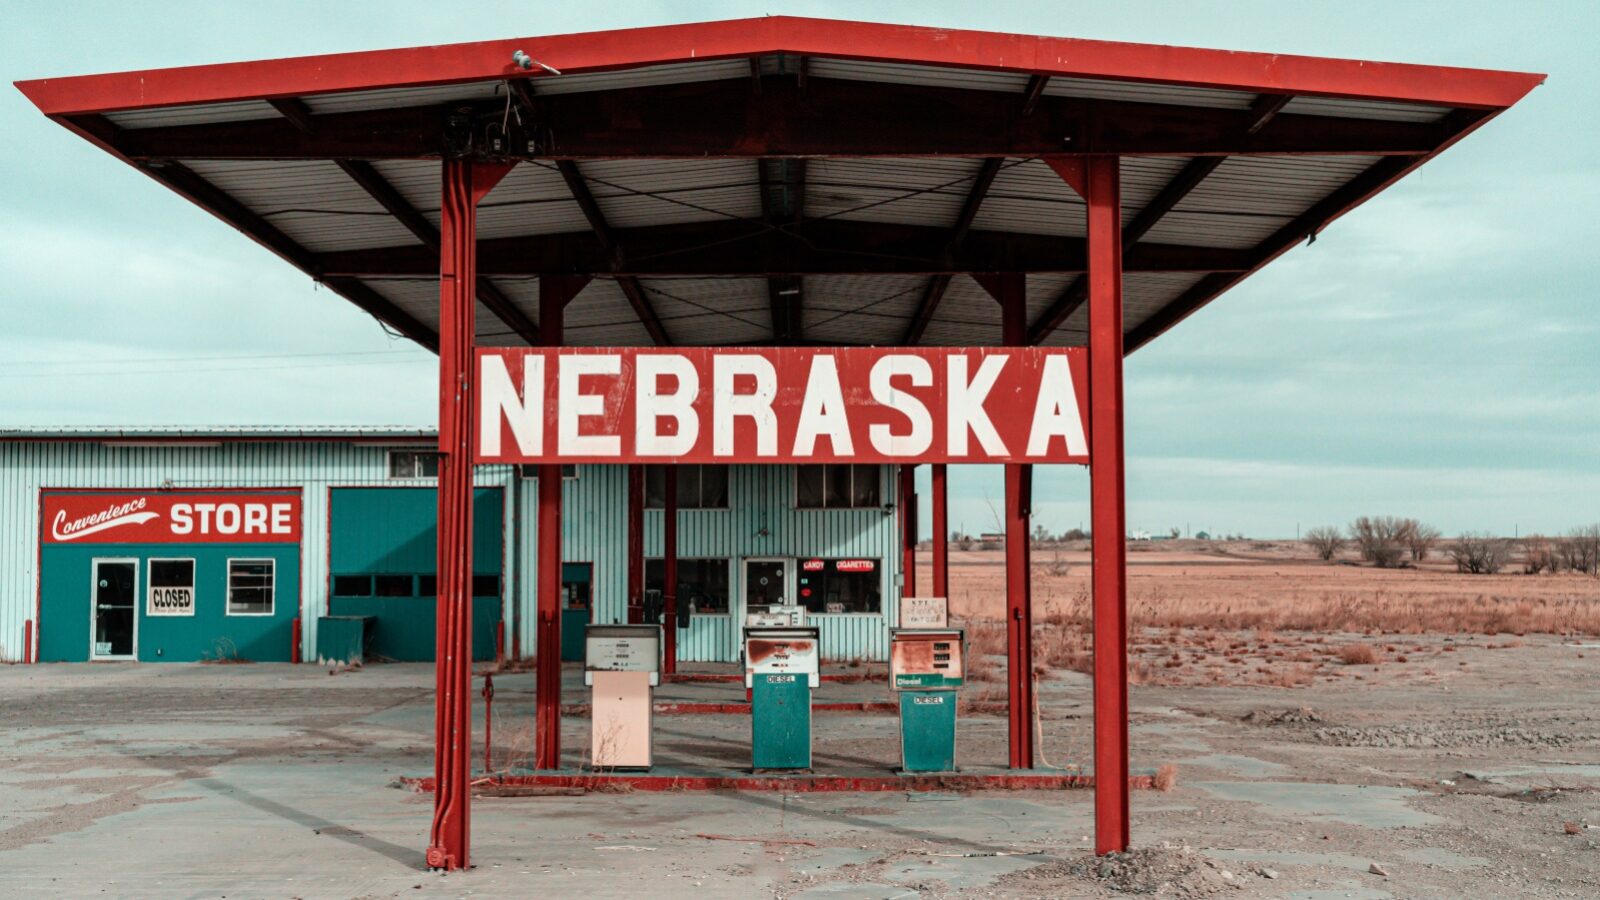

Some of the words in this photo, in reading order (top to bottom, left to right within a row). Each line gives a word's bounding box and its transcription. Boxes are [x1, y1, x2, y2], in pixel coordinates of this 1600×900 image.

[480, 354, 1089, 456] NEBRASKA
[52, 497, 147, 540] Convenience
[170, 503, 292, 534] STORE
[803, 561, 825, 569] CANDY
[836, 561, 874, 569] CIGARETTES
[153, 589, 191, 607] CLOSED
[767, 675, 794, 683] DIESEL
[915, 696, 942, 704] DIESEL
